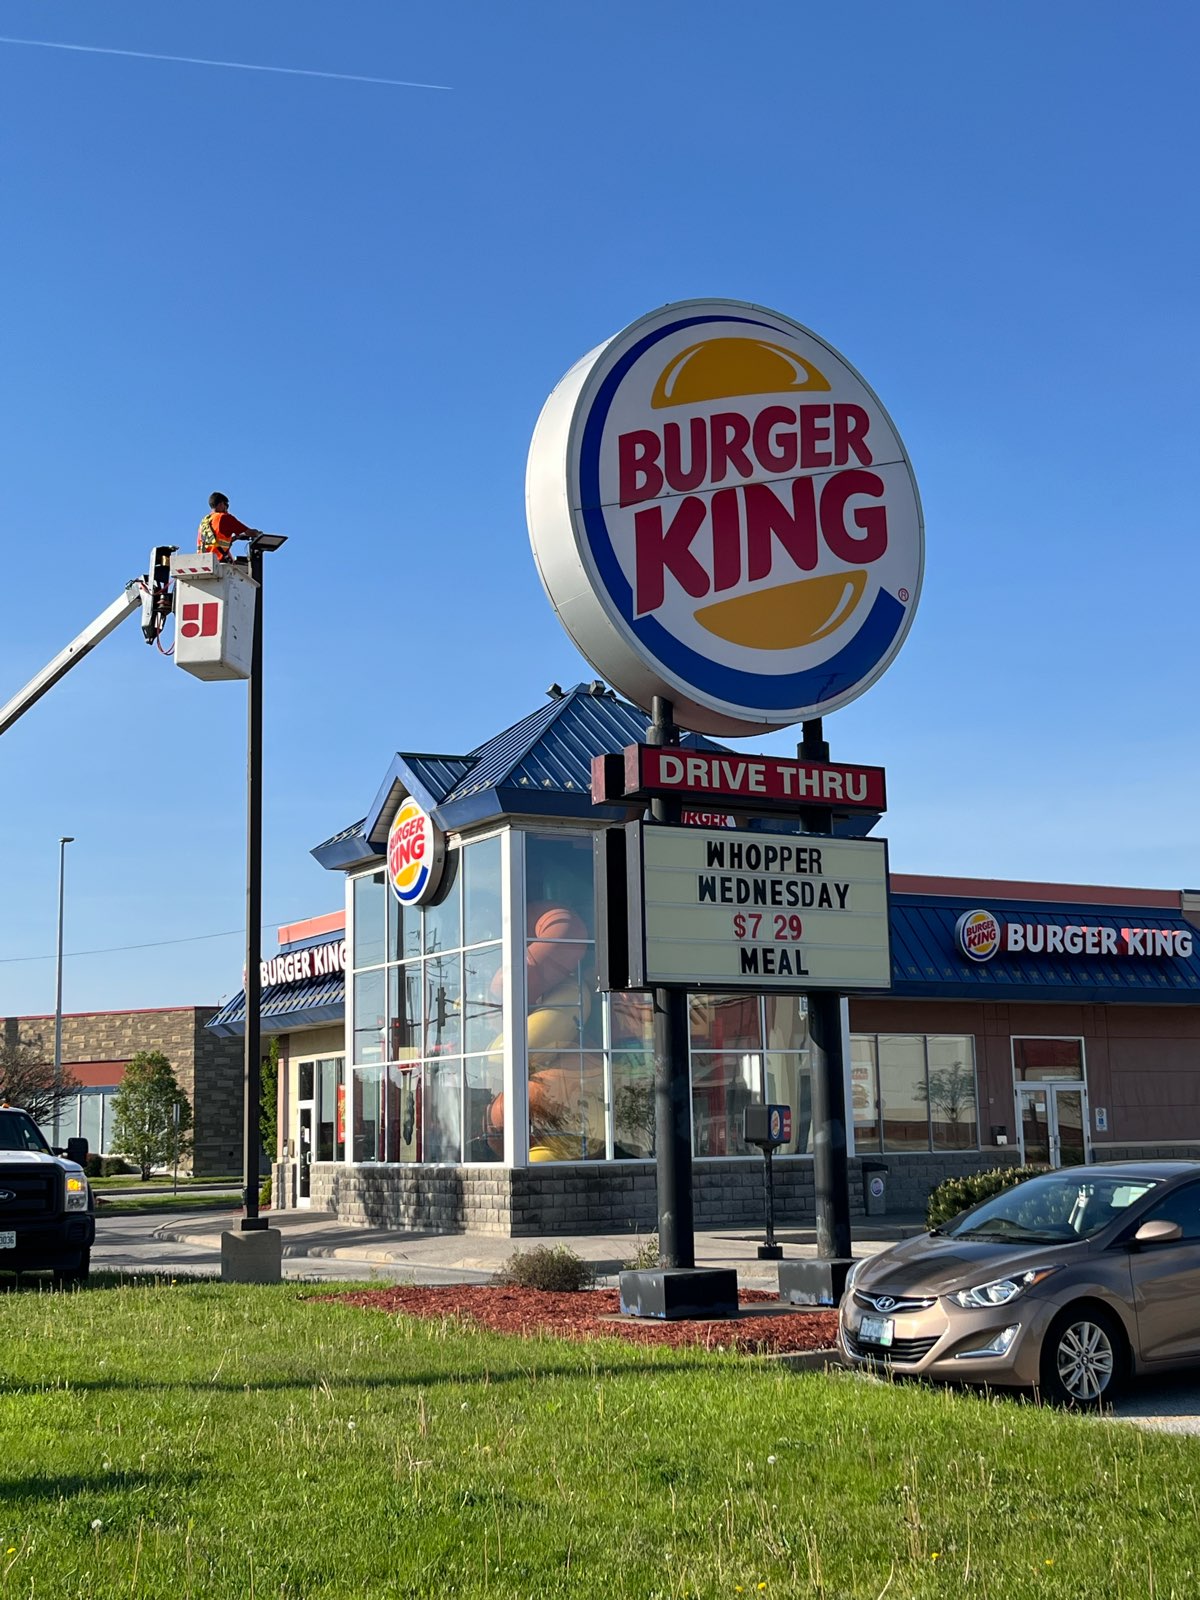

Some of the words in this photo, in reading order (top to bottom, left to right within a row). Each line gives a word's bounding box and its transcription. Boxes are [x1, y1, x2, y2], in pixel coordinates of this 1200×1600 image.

[618, 403, 873, 509] BURGER
[634, 469, 888, 615] KING
[659, 755, 766, 792] DRIVE
[777, 766, 868, 801] THRU
[390, 816, 425, 856] BURGER
[706, 840, 823, 875] WHOPPER
[698, 875, 850, 909] WEDNESDAY
[733, 912, 762, 940] $7
[773, 914, 802, 940] 29
[967, 920, 995, 937] BURGER
[967, 929, 996, 948] KING
[1007, 922, 1118, 955] BURGER
[1127, 928, 1193, 958] KING
[260, 951, 311, 988] BURGER
[740, 947, 809, 976] MEAL
